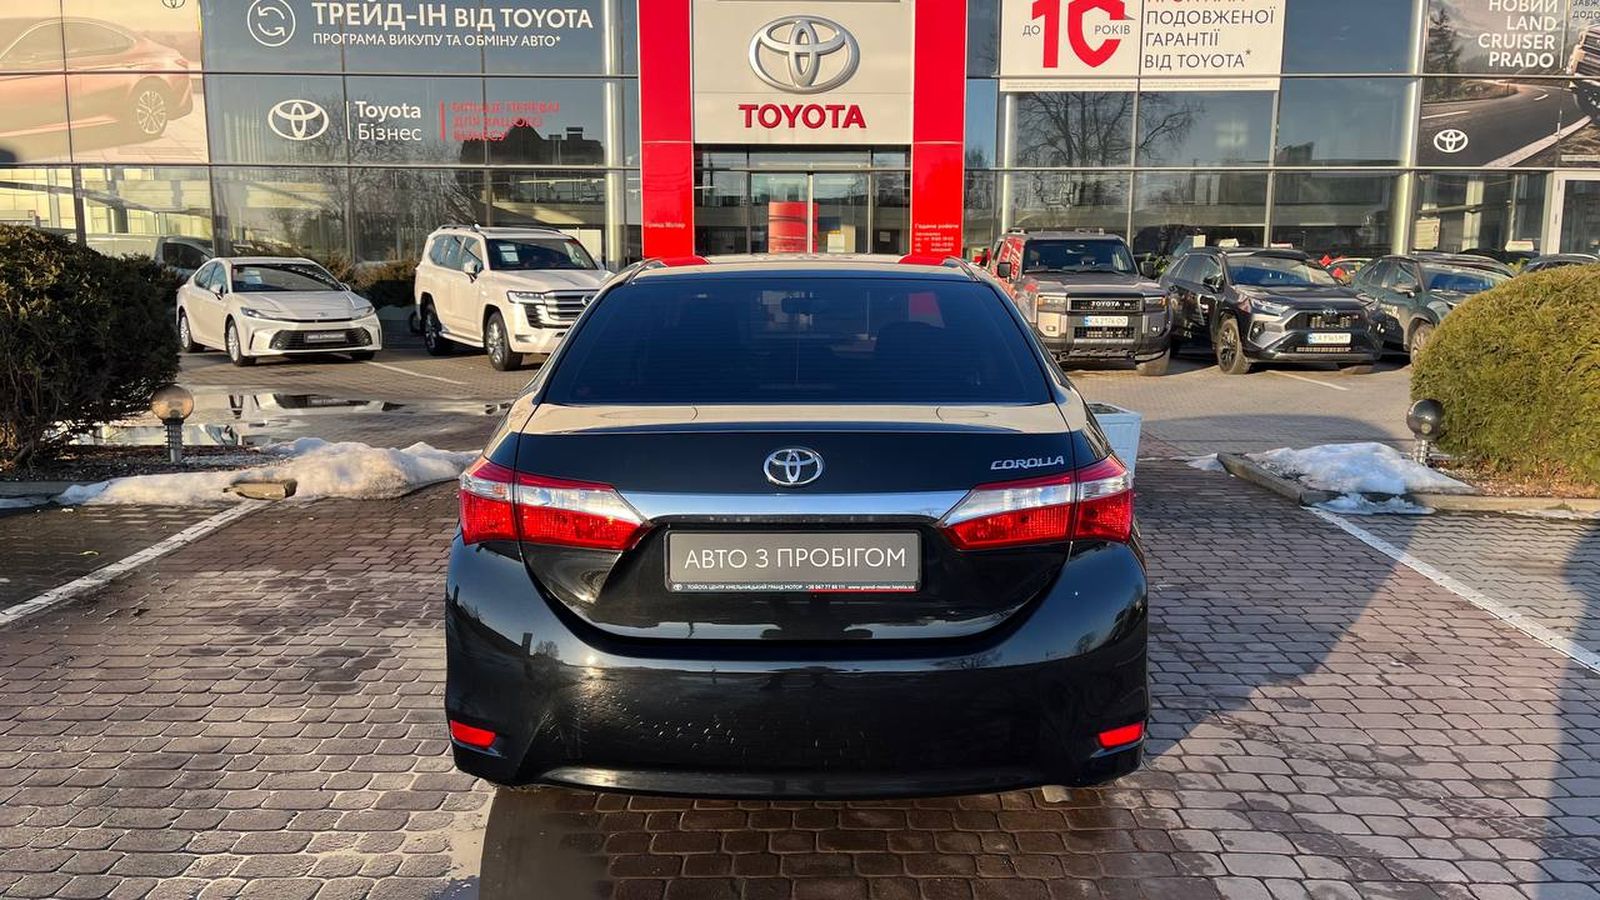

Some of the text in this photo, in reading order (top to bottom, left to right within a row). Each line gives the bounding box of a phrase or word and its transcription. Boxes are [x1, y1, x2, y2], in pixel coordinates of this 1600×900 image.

[311, 0, 594, 31] ТРЕЙД-ІН ВІД TOYOTA
[1146, 6, 1276, 27] ПОДОВЖЕНОЇ
[1506, 16, 1557, 31] LAND
[1022, 25, 1041, 36] ДО
[1094, 25, 1131, 36] РОКІВ
[1145, 28, 1220, 47] ГАРАНТІЇ
[312, 33, 386, 46] ПРОГРАМА
[389, 34, 443, 46] ВИКУПУ
[446, 35, 462, 46] ТА
[464, 35, 518, 48] ОБМІНУ
[1478, 33, 1556, 50] CRUISER
[1144, 54, 1173, 71] ВІД
[1488, 52, 1555, 69] PRADO
[355, 101, 422, 122] Toyota
[738, 104, 867, 129] TOYOTA
[357, 123, 422, 141] Бізнес
[990, 455, 1065, 470] COROLLA
[684, 549, 748, 569] АВТО
[777, 548, 906, 568] ПРОБІГОМ
